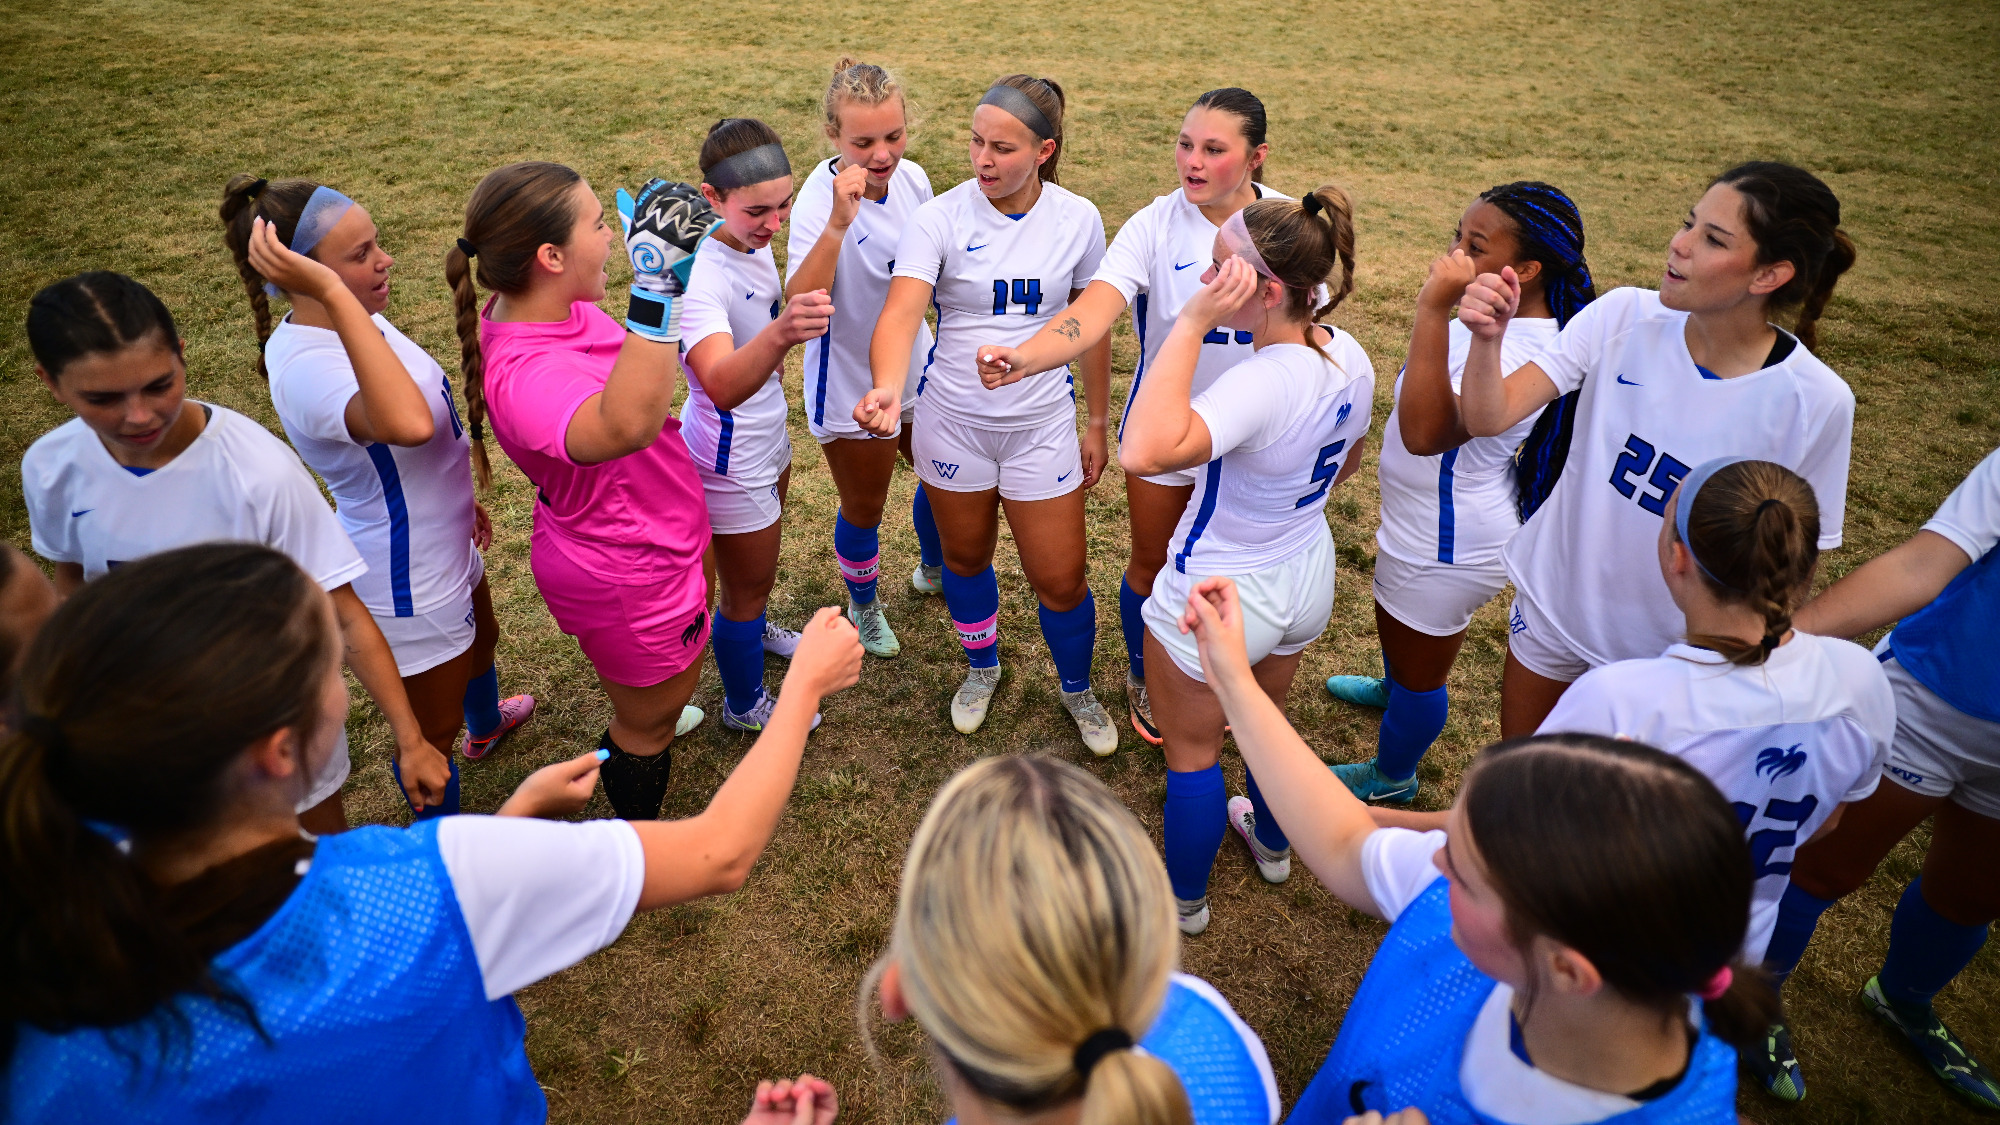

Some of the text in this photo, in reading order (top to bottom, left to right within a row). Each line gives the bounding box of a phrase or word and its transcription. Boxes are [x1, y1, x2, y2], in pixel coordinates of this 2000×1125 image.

[993, 279, 1044, 316] 14
[932, 459, 960, 480] W
[1294, 438, 1347, 510] 5
[1608, 433, 1693, 518] 25
